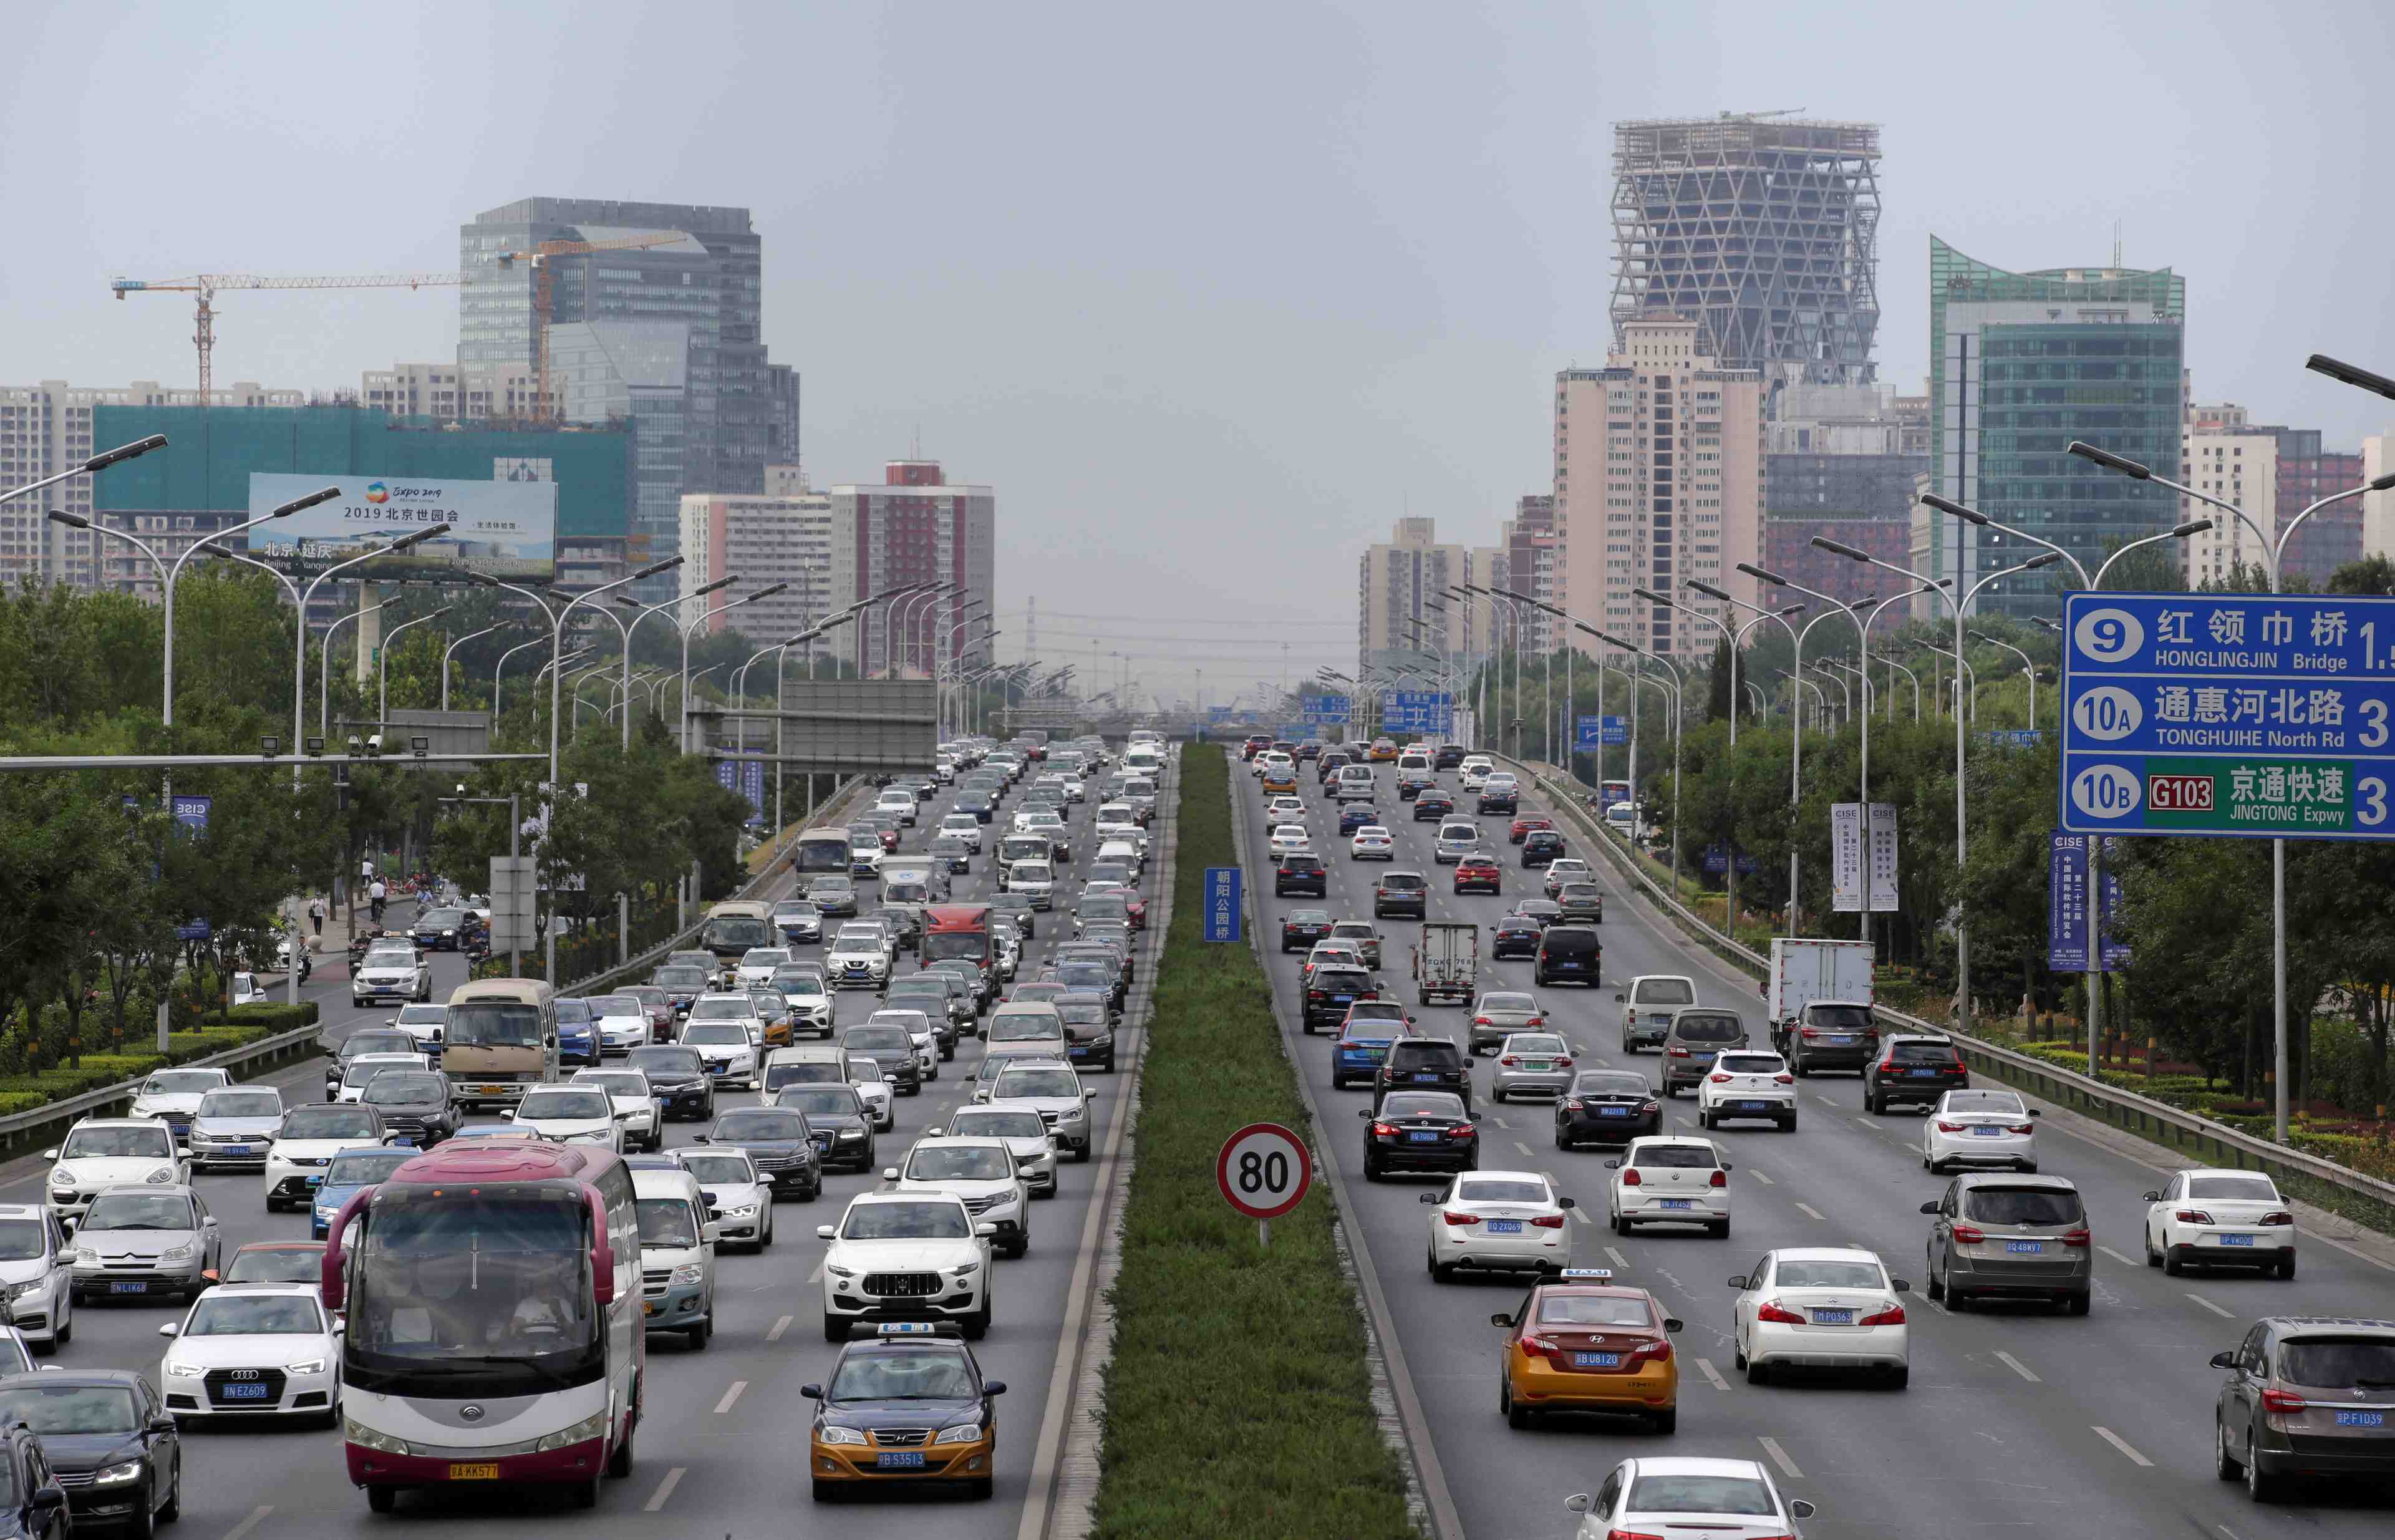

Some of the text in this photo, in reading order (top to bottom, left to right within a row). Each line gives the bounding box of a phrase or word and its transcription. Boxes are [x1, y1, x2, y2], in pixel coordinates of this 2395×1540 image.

[344, 506, 381, 519] 2019
[385, 508, 458, 522] 北京世园会
[2093, 618, 2126, 654] 9
[2157, 609, 2348, 647] 红领巾桥
[2359, 622, 2395, 670] 1.
[2155, 649, 2348, 672] HONGLINGJIN Bridge
[2154, 685, 2346, 726] 通惠河北路
[2358, 699, 2389, 748] 3
[2156, 728, 2345, 748] TONGHUIHE North Rd
[2152, 778, 2212, 807] G103
[2230, 765, 2344, 803] 京通快速
[2357, 777, 2388, 825] 3
[1836, 810, 1857, 818] CISE
[1873, 810, 1894, 818] CISE
[2230, 805, 2345, 825] JINGTONG Expwy
[2054, 837, 2083, 846] CISE
[1216, 871, 1231, 939] 朝阳公园桥
[2063, 855, 2071, 939] 中国国际软件博览会
[2074, 874, 2083, 920] 第二十三届
[1239, 1151, 1289, 1193] 80
